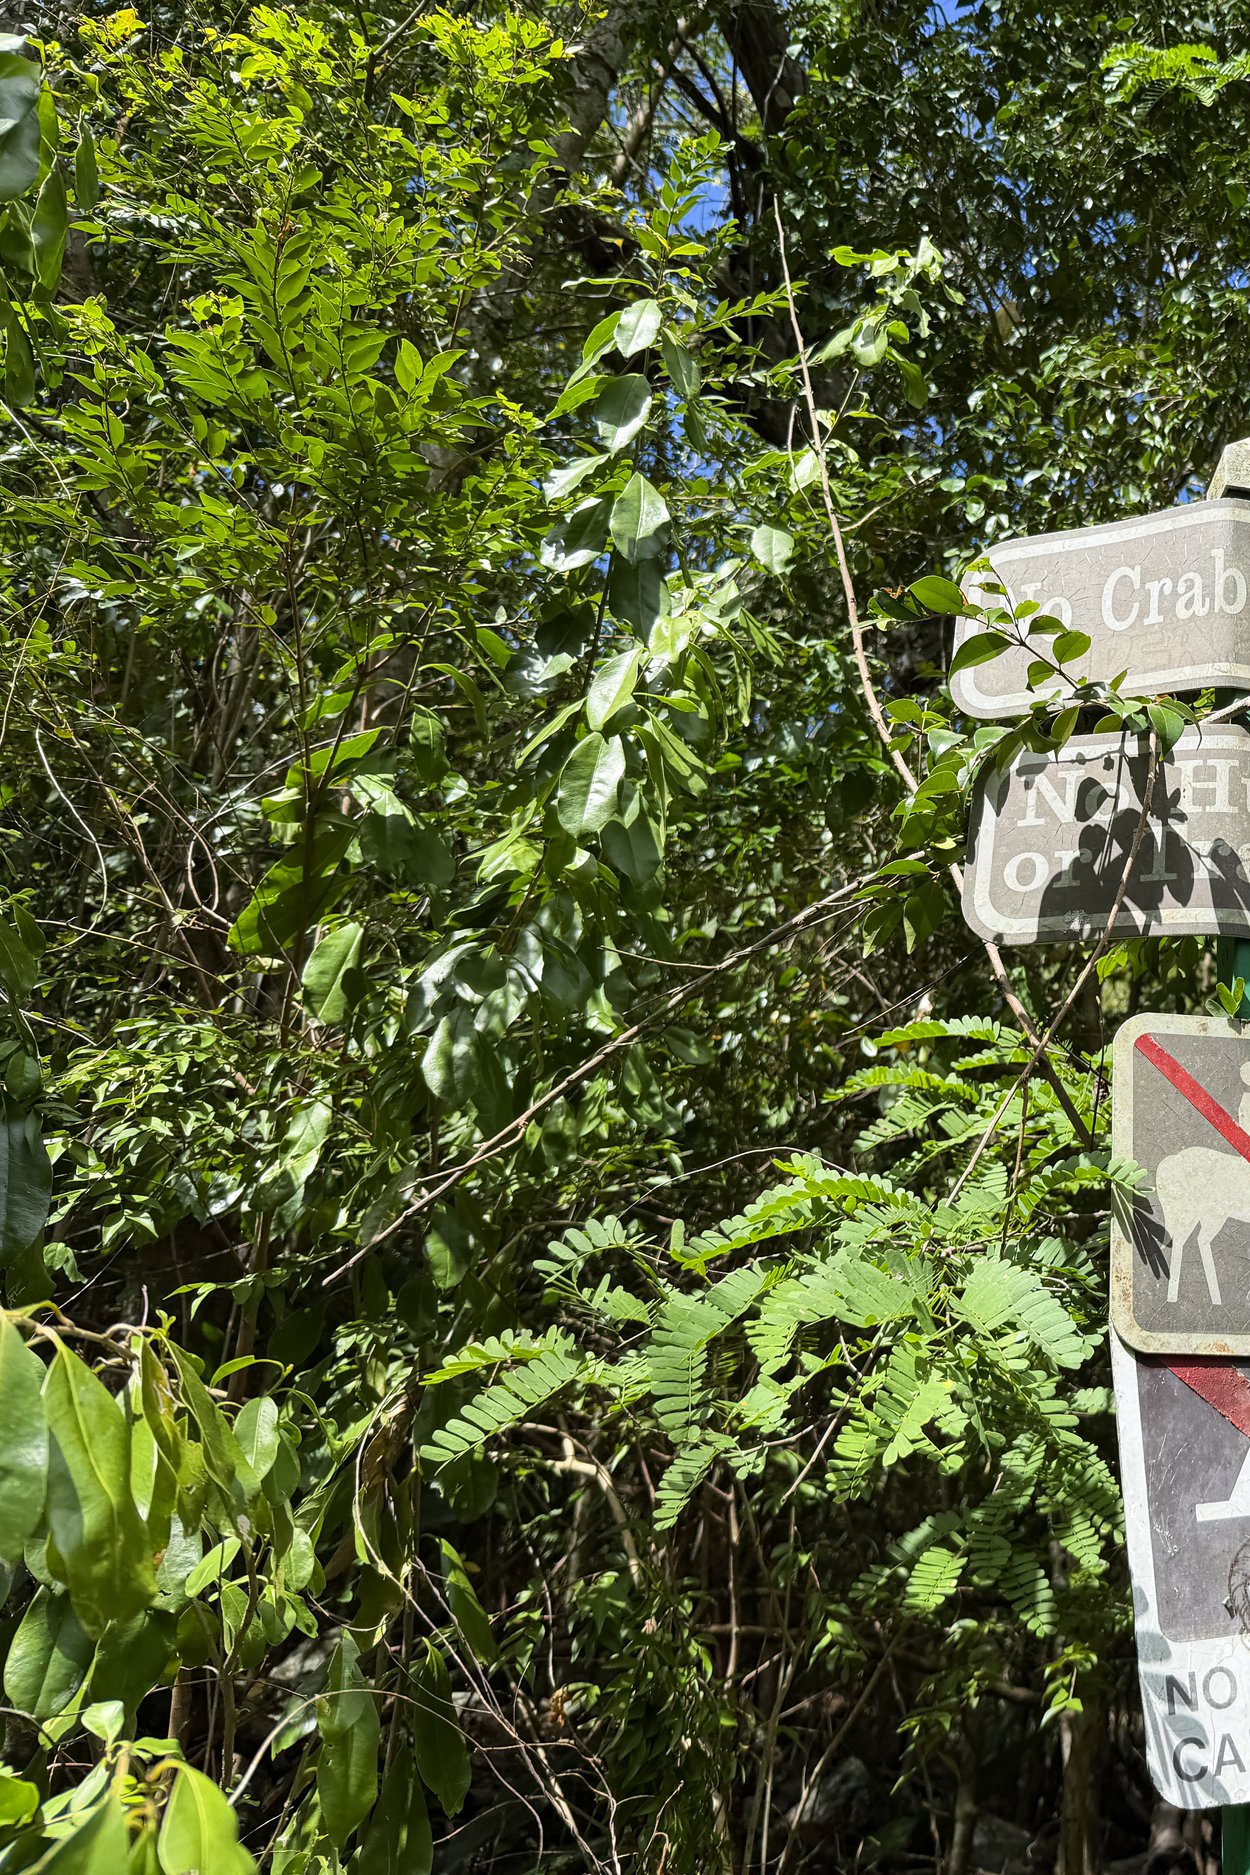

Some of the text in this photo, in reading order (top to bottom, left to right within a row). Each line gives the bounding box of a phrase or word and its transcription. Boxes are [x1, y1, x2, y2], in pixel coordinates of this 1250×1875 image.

[1102, 549, 1248, 631] Crab
[1016, 769, 1132, 827] No
[1003, 848, 1093, 893] or
[1164, 1666, 1237, 1716] NO
